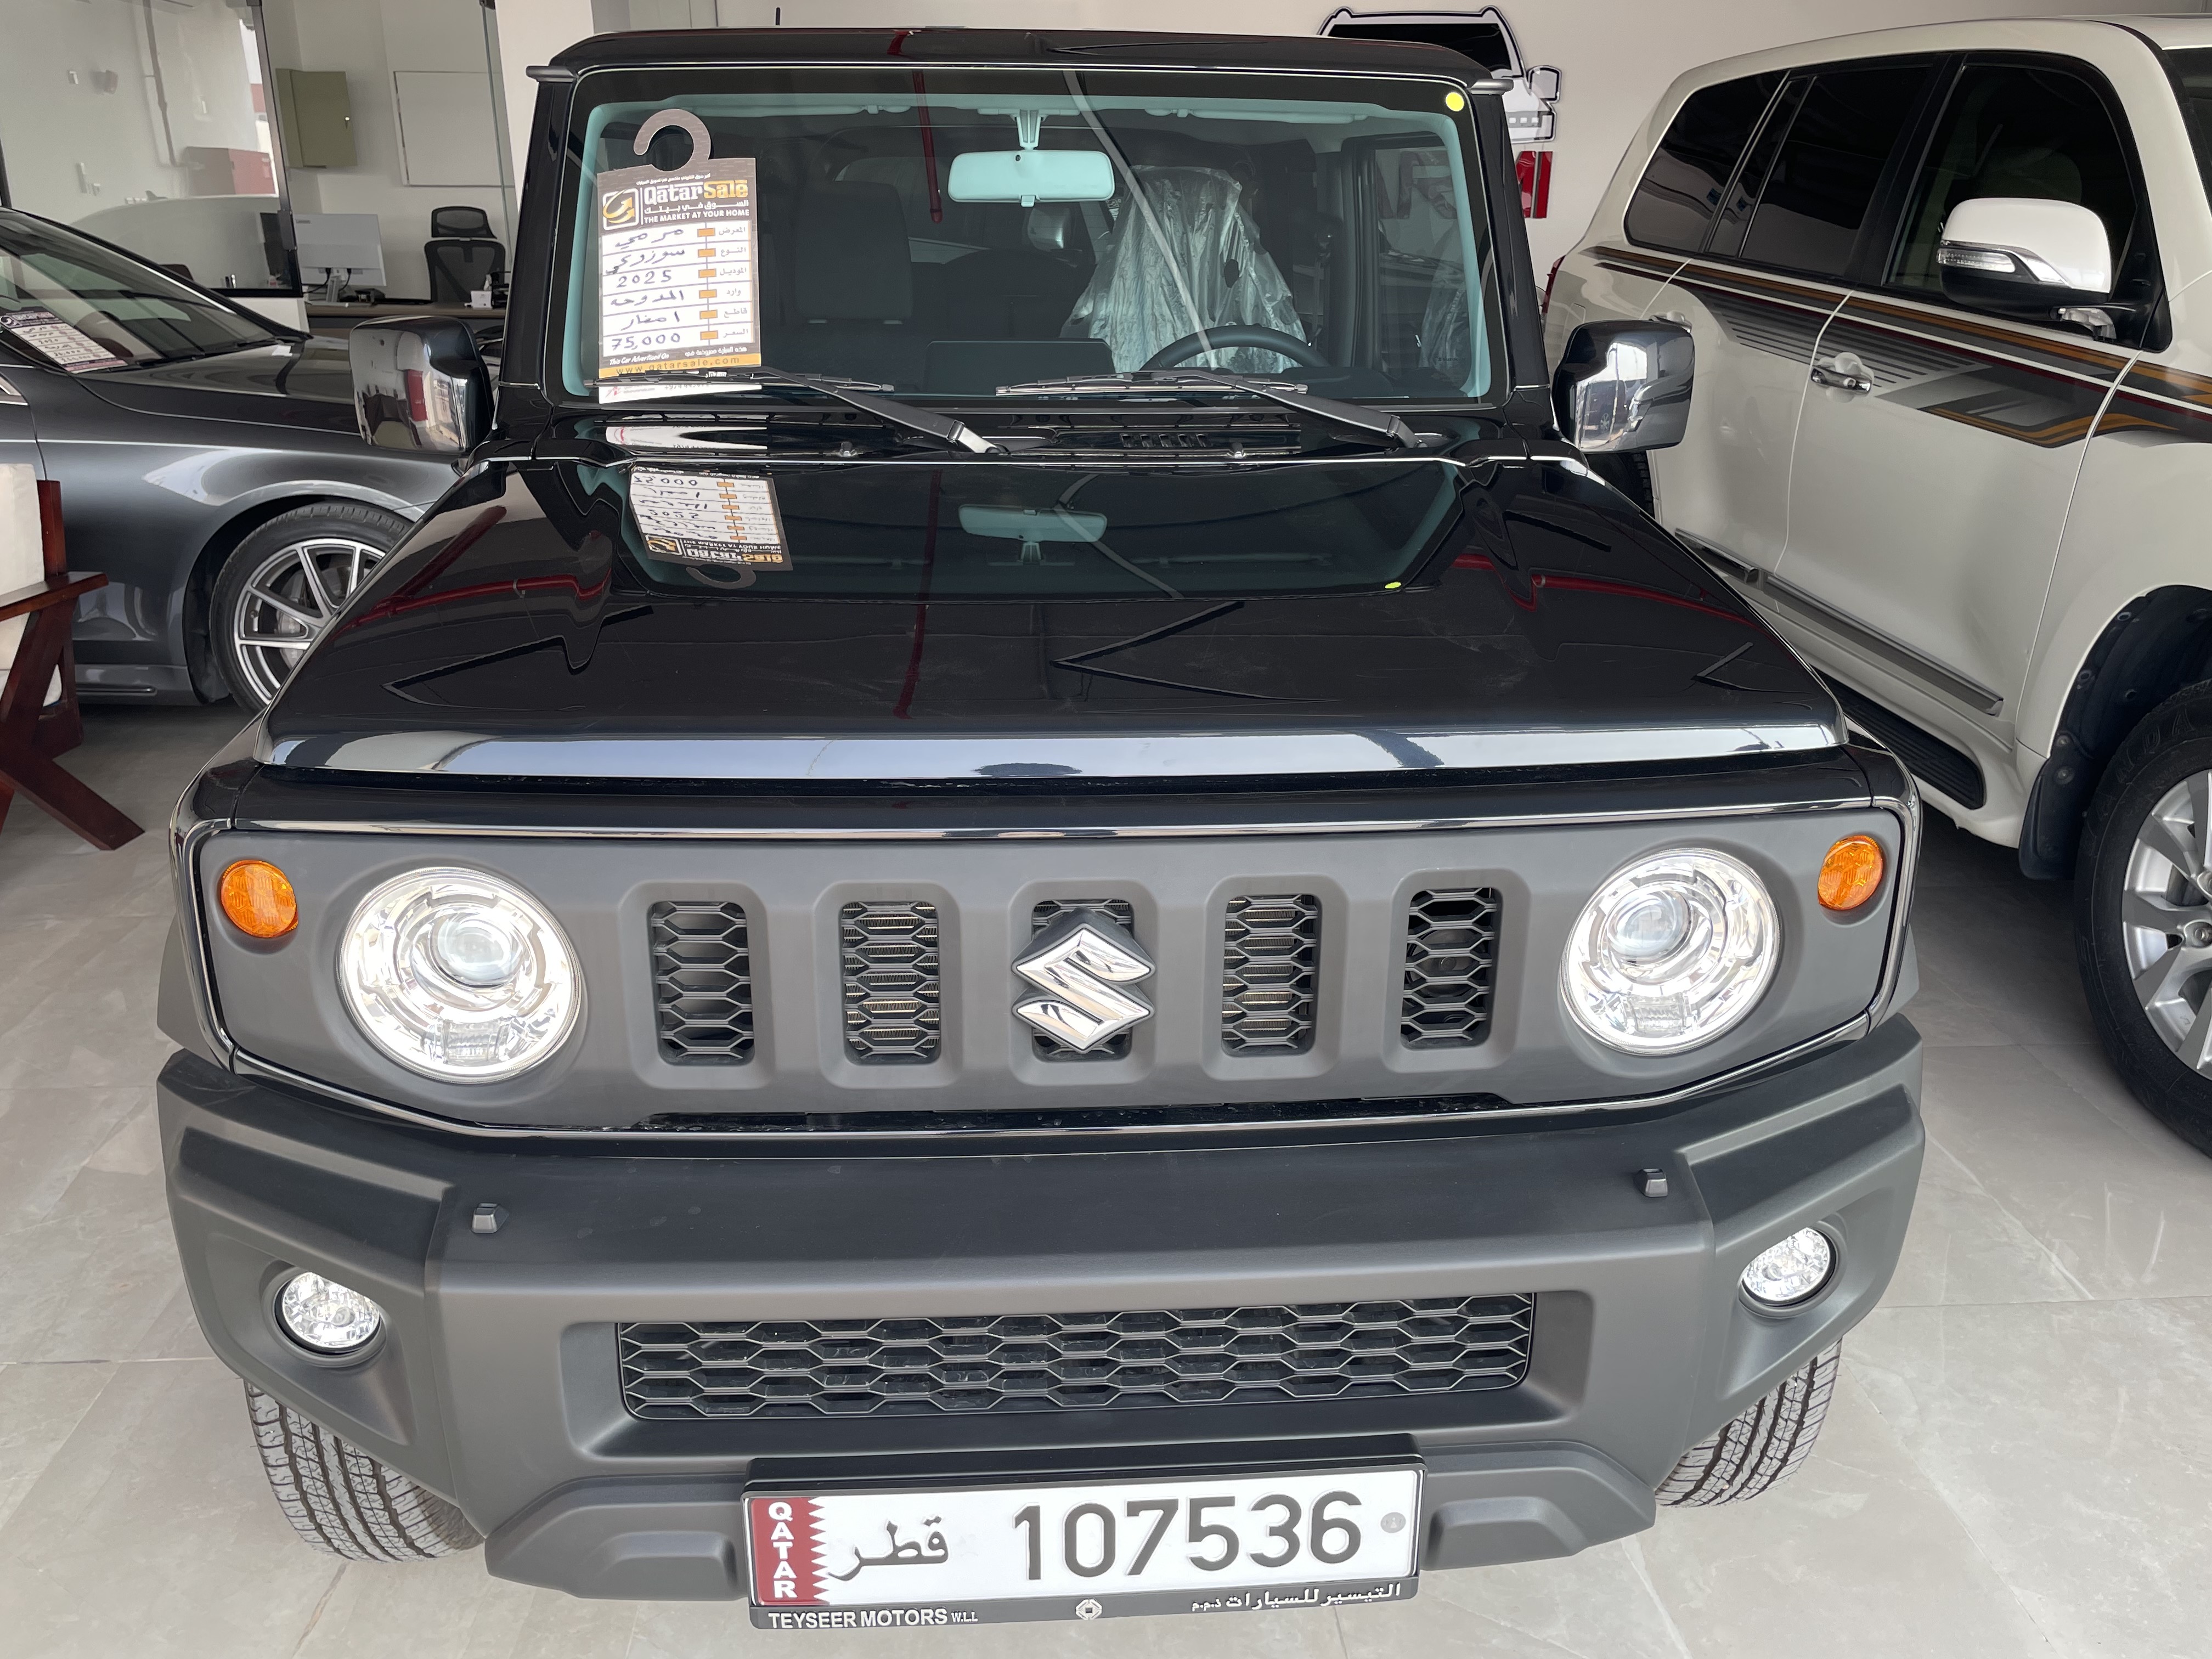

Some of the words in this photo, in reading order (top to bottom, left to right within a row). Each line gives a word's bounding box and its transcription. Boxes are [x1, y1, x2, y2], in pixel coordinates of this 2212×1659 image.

[660, 212, 690, 222] MARKET
[616, 269, 672, 288] 2025
[612, 332, 681, 351] 75,000
[631, 353, 661, 363] Advertised
[1013, 1490, 1362, 1581] 107536
[768, 1501, 798, 1599] QATAR
[827, 1515, 949, 1581] قطر
[1226, 1588, 1319, 1610] للسيارات
[1320, 1582, 1401, 1607] التيسير
[768, 1611, 856, 1629] TEYSEER
[860, 1608, 948, 1627] MOTORS
